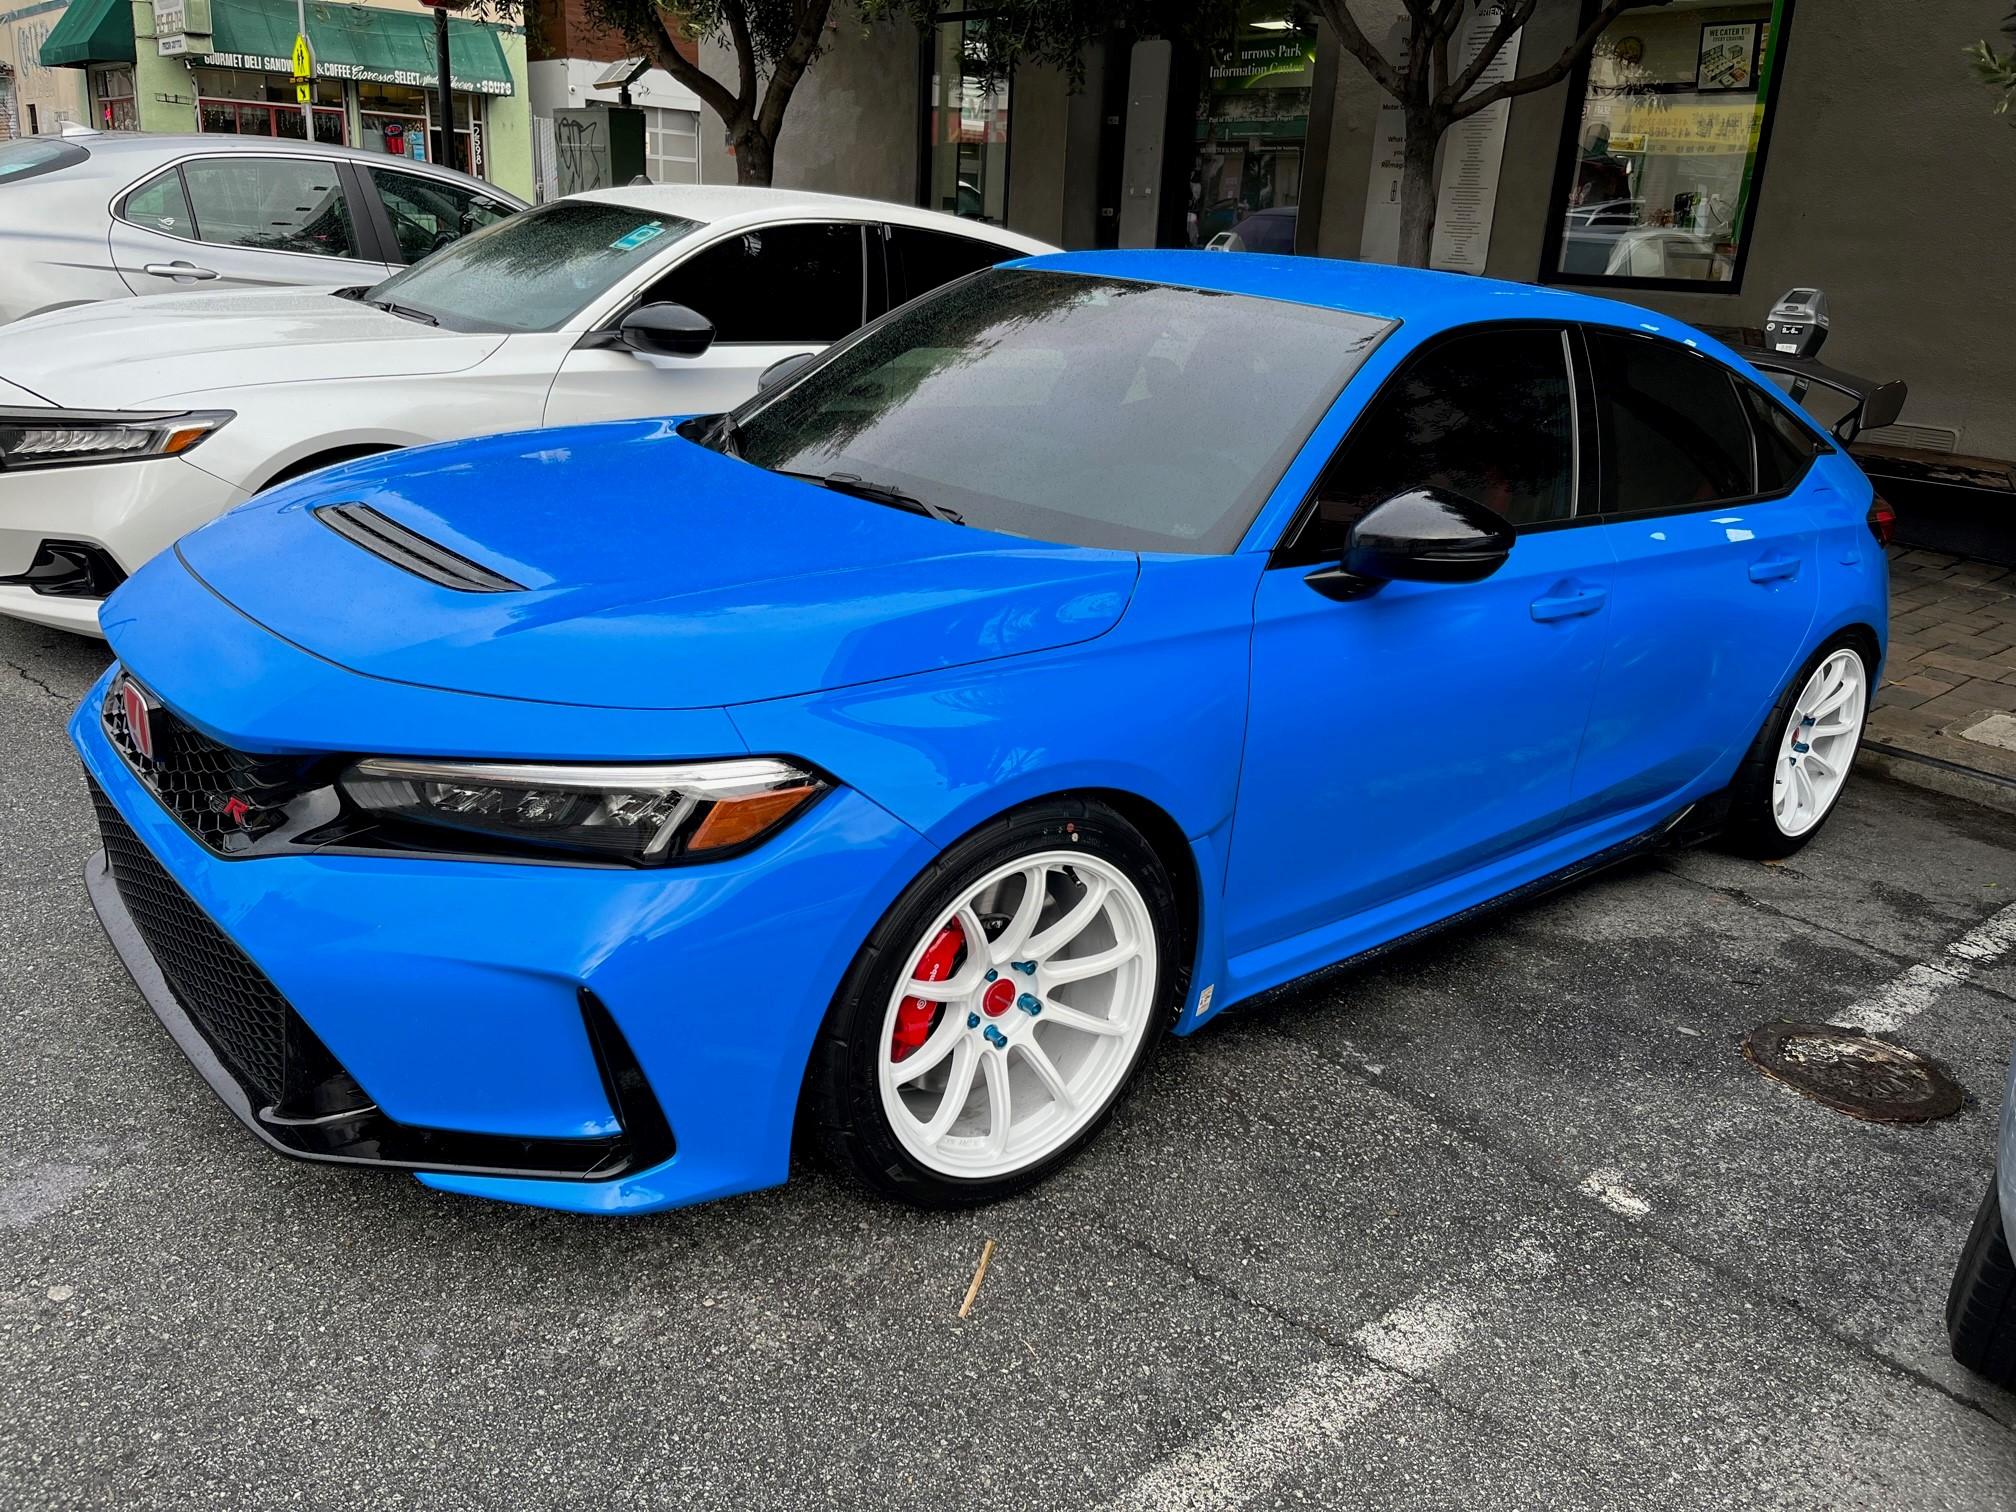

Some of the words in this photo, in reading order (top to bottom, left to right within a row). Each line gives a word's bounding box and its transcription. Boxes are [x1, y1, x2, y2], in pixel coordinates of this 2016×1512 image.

[1719, 28, 1740, 36] CATER
[1241, 48, 1277, 61] urrows
[1278, 43, 1302, 58] Park
[204, 52, 243, 68] GOURMET
[244, 56, 262, 69] DELI
[264, 57, 295, 73] SANDW
[324, 62, 351, 78] COFFEE
[351, 64, 395, 82] Espresso
[394, 70, 421, 86] SELECT
[482, 80, 512, 95] SOUPS
[1209, 62, 1268, 79] Information
[473, 127, 482, 165] 2598
